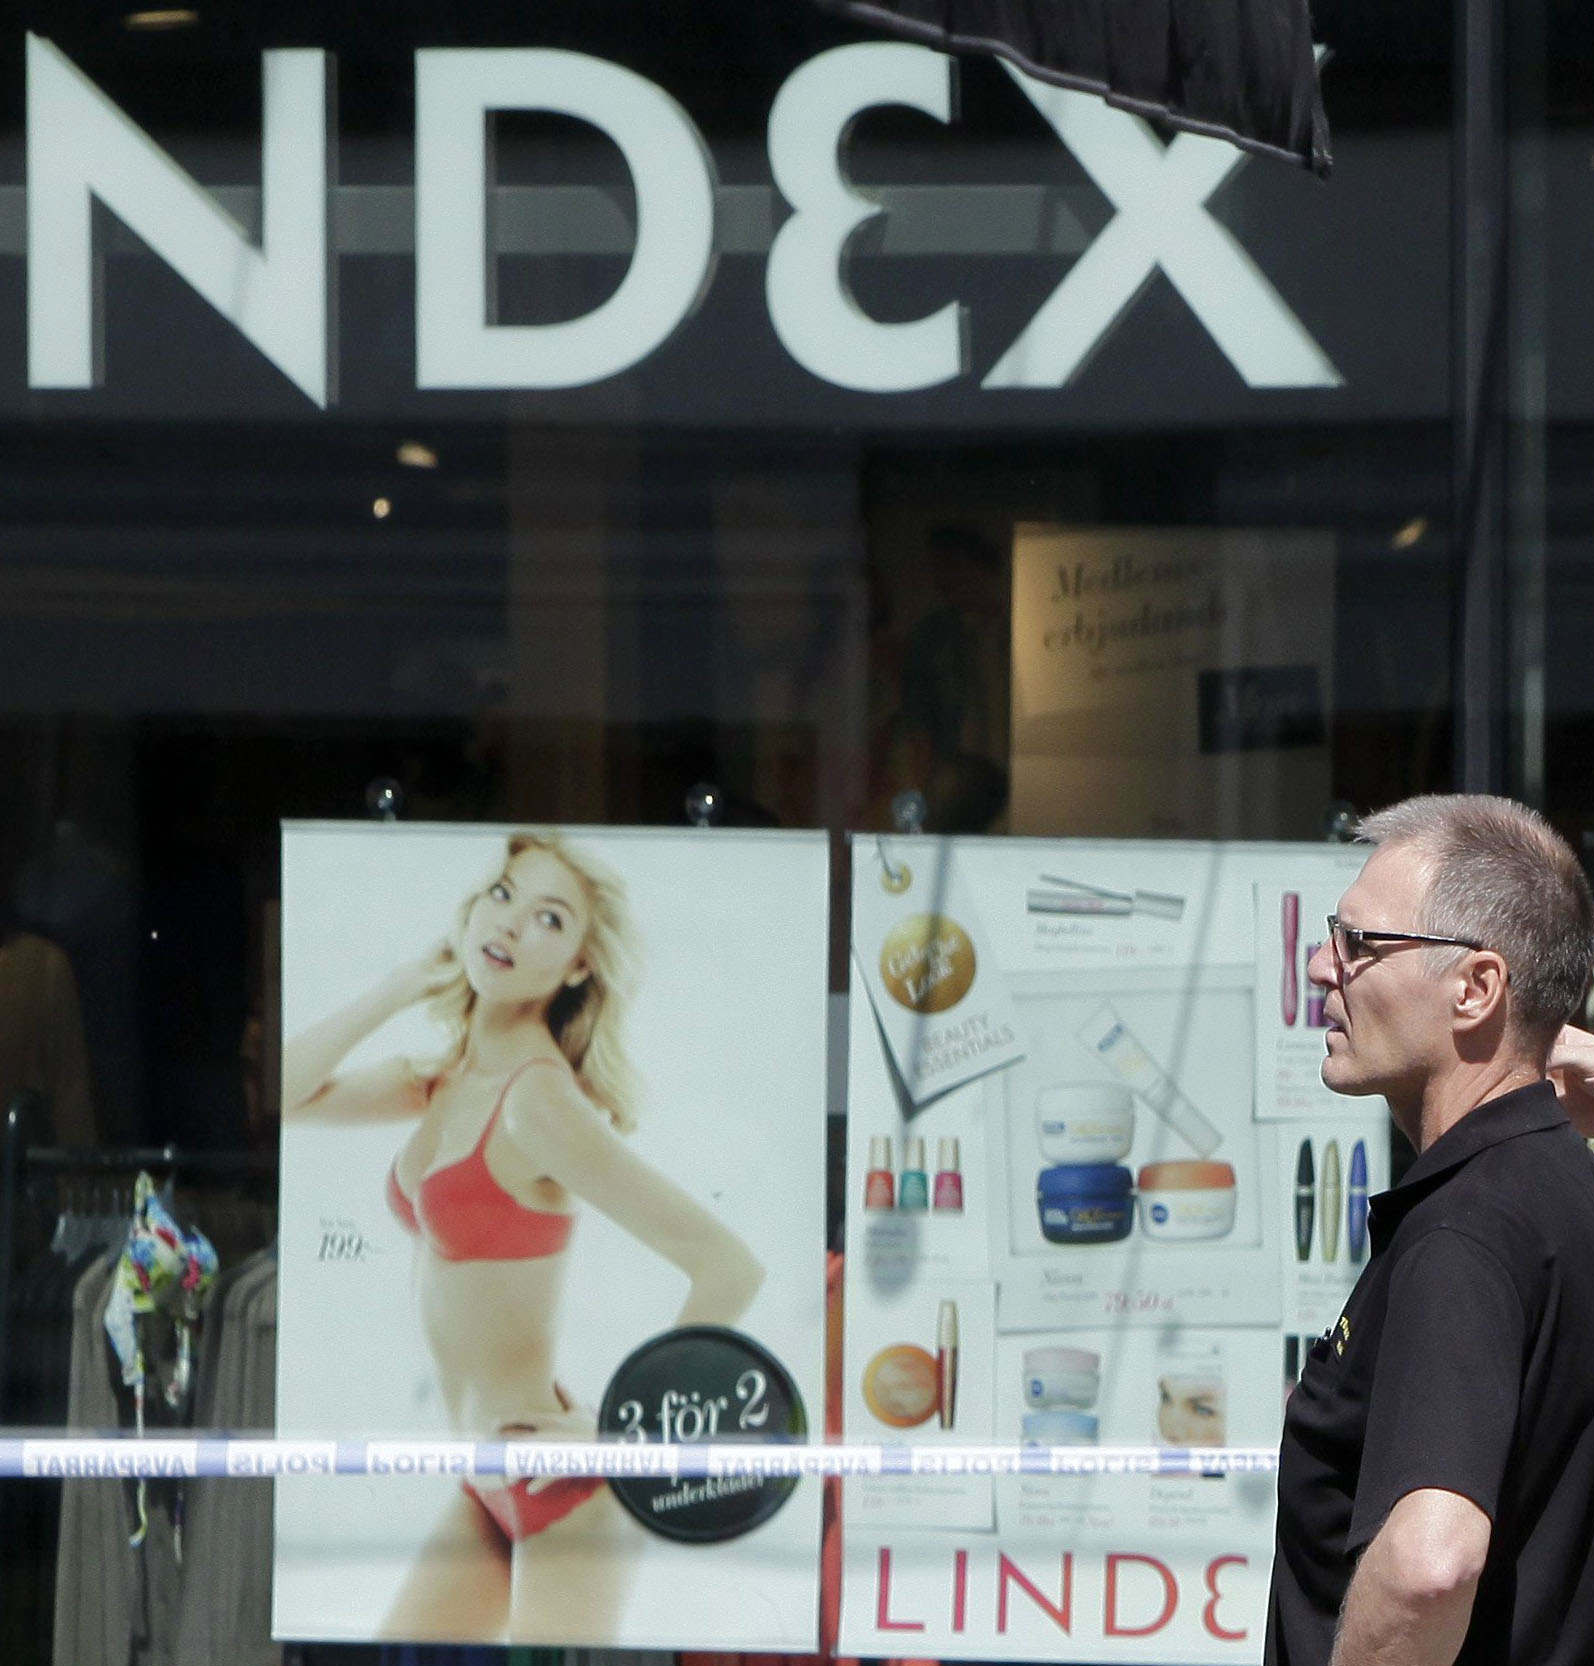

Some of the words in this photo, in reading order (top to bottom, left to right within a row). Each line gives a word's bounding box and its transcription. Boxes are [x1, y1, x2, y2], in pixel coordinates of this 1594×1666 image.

[617, 1399, 648, 1444] 3
[656, 1389, 729, 1446] för
[736, 1368, 769, 1431] 2
[876, 1546, 1249, 1641] LINDE
